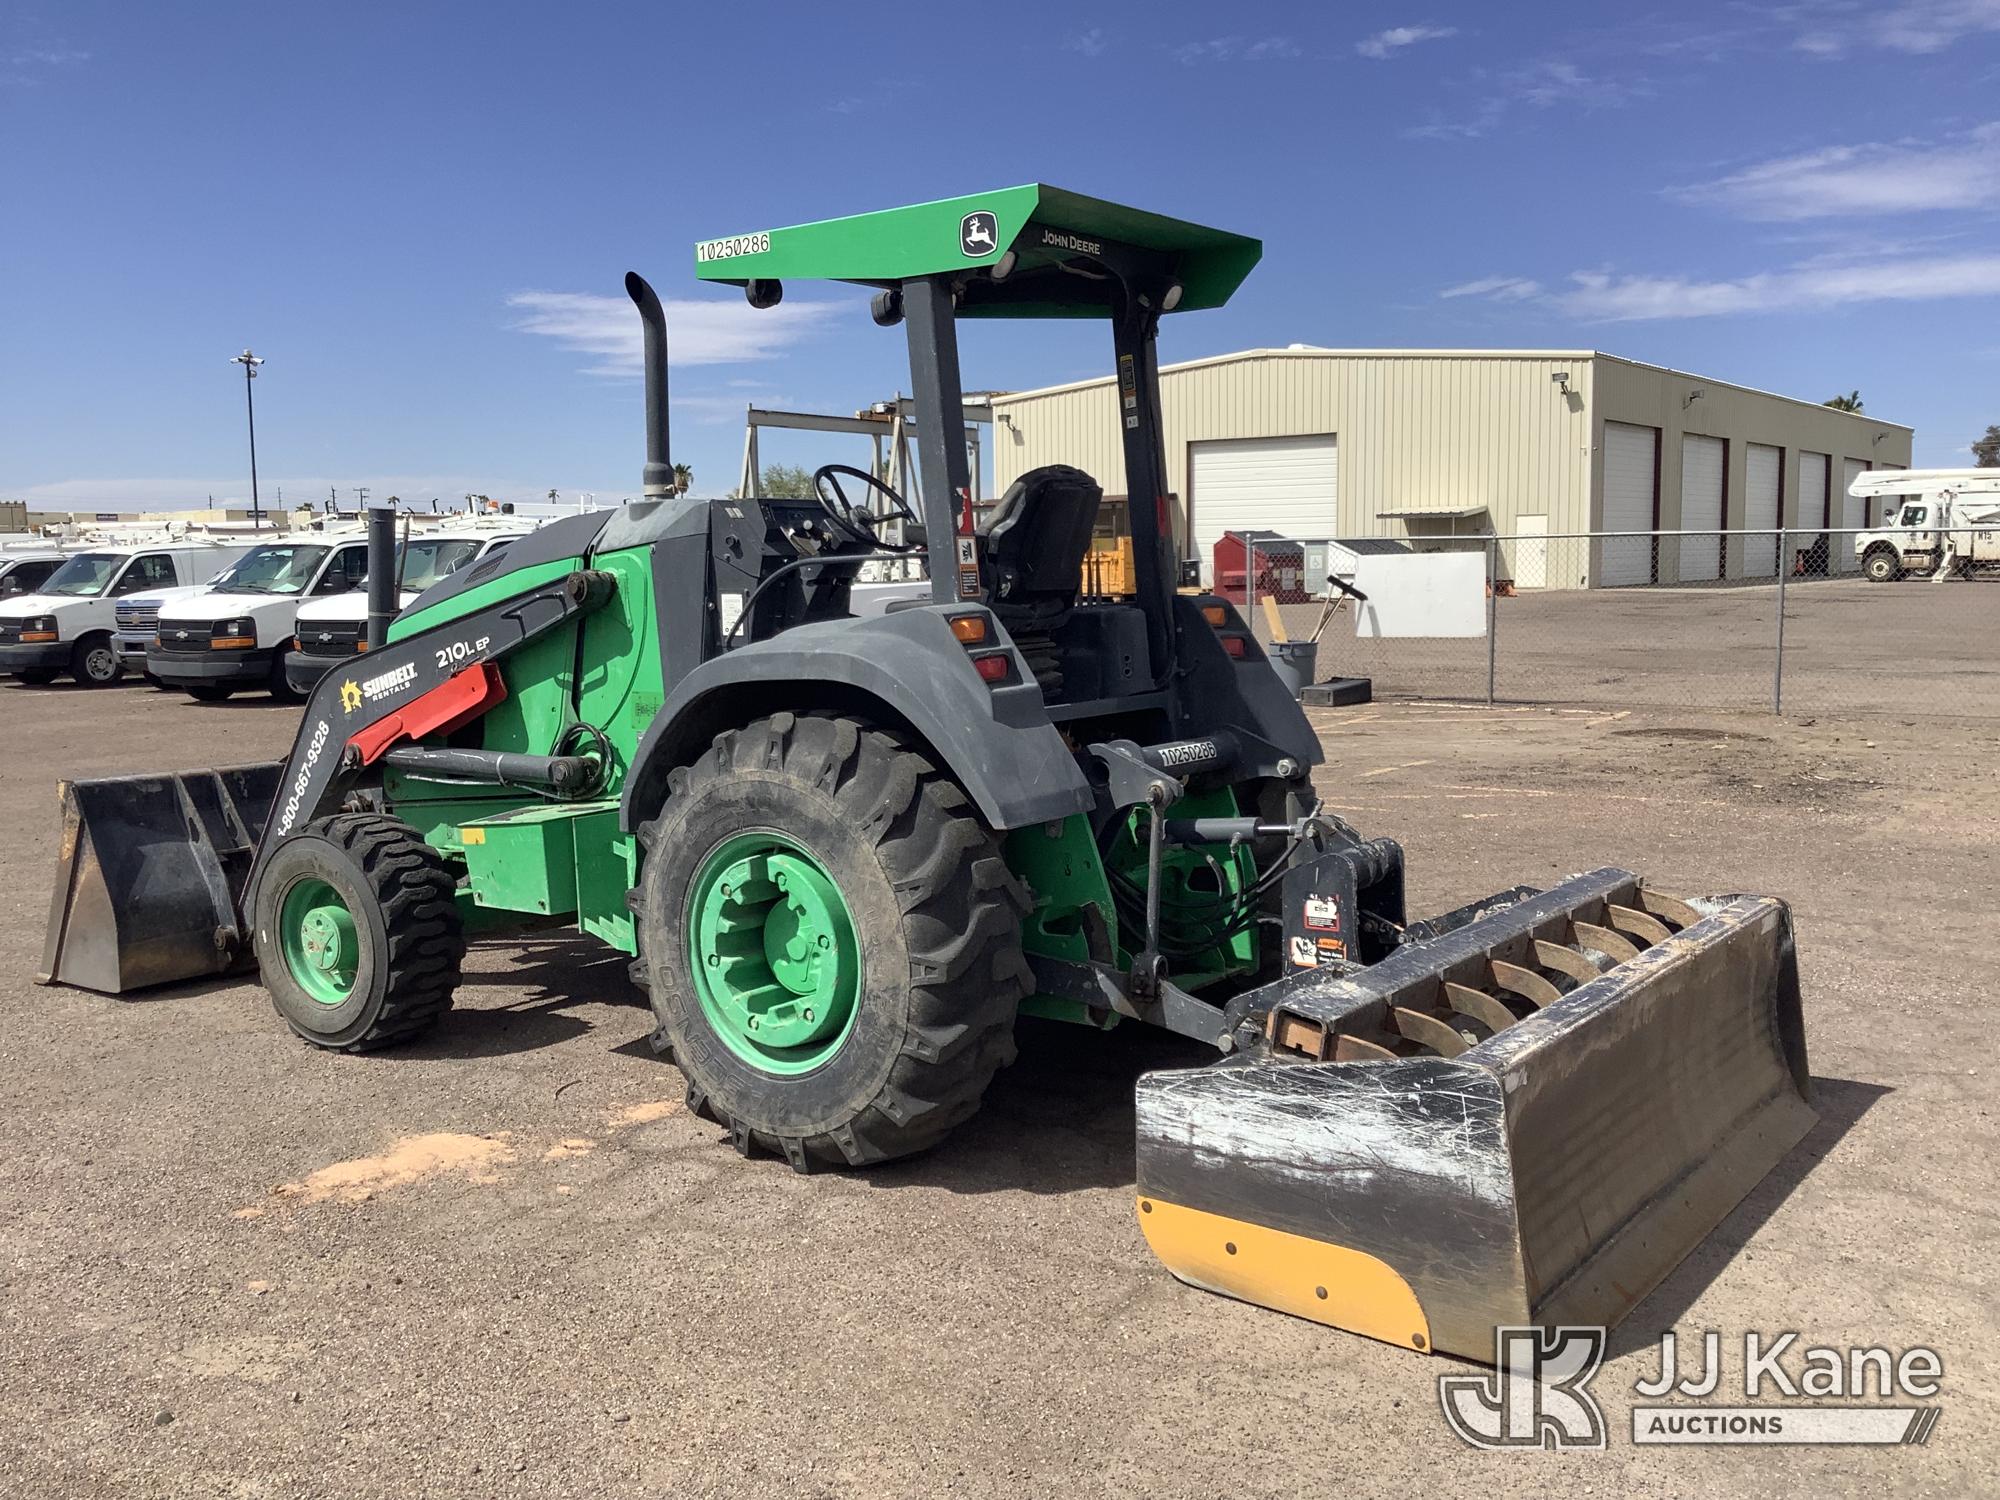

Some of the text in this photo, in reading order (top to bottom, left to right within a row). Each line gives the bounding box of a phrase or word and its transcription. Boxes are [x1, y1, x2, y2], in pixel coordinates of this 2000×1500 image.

[699, 234, 769, 261] 10250286
[1042, 229, 1101, 255] JOHN DEERE
[435, 636, 490, 668] 210L EP
[362, 662, 416, 698] SUNBELT
[372, 681, 411, 702] RENTALS
[1161, 743, 1216, 765] 10250286
[277, 720, 330, 837] 1-800-667-9328
